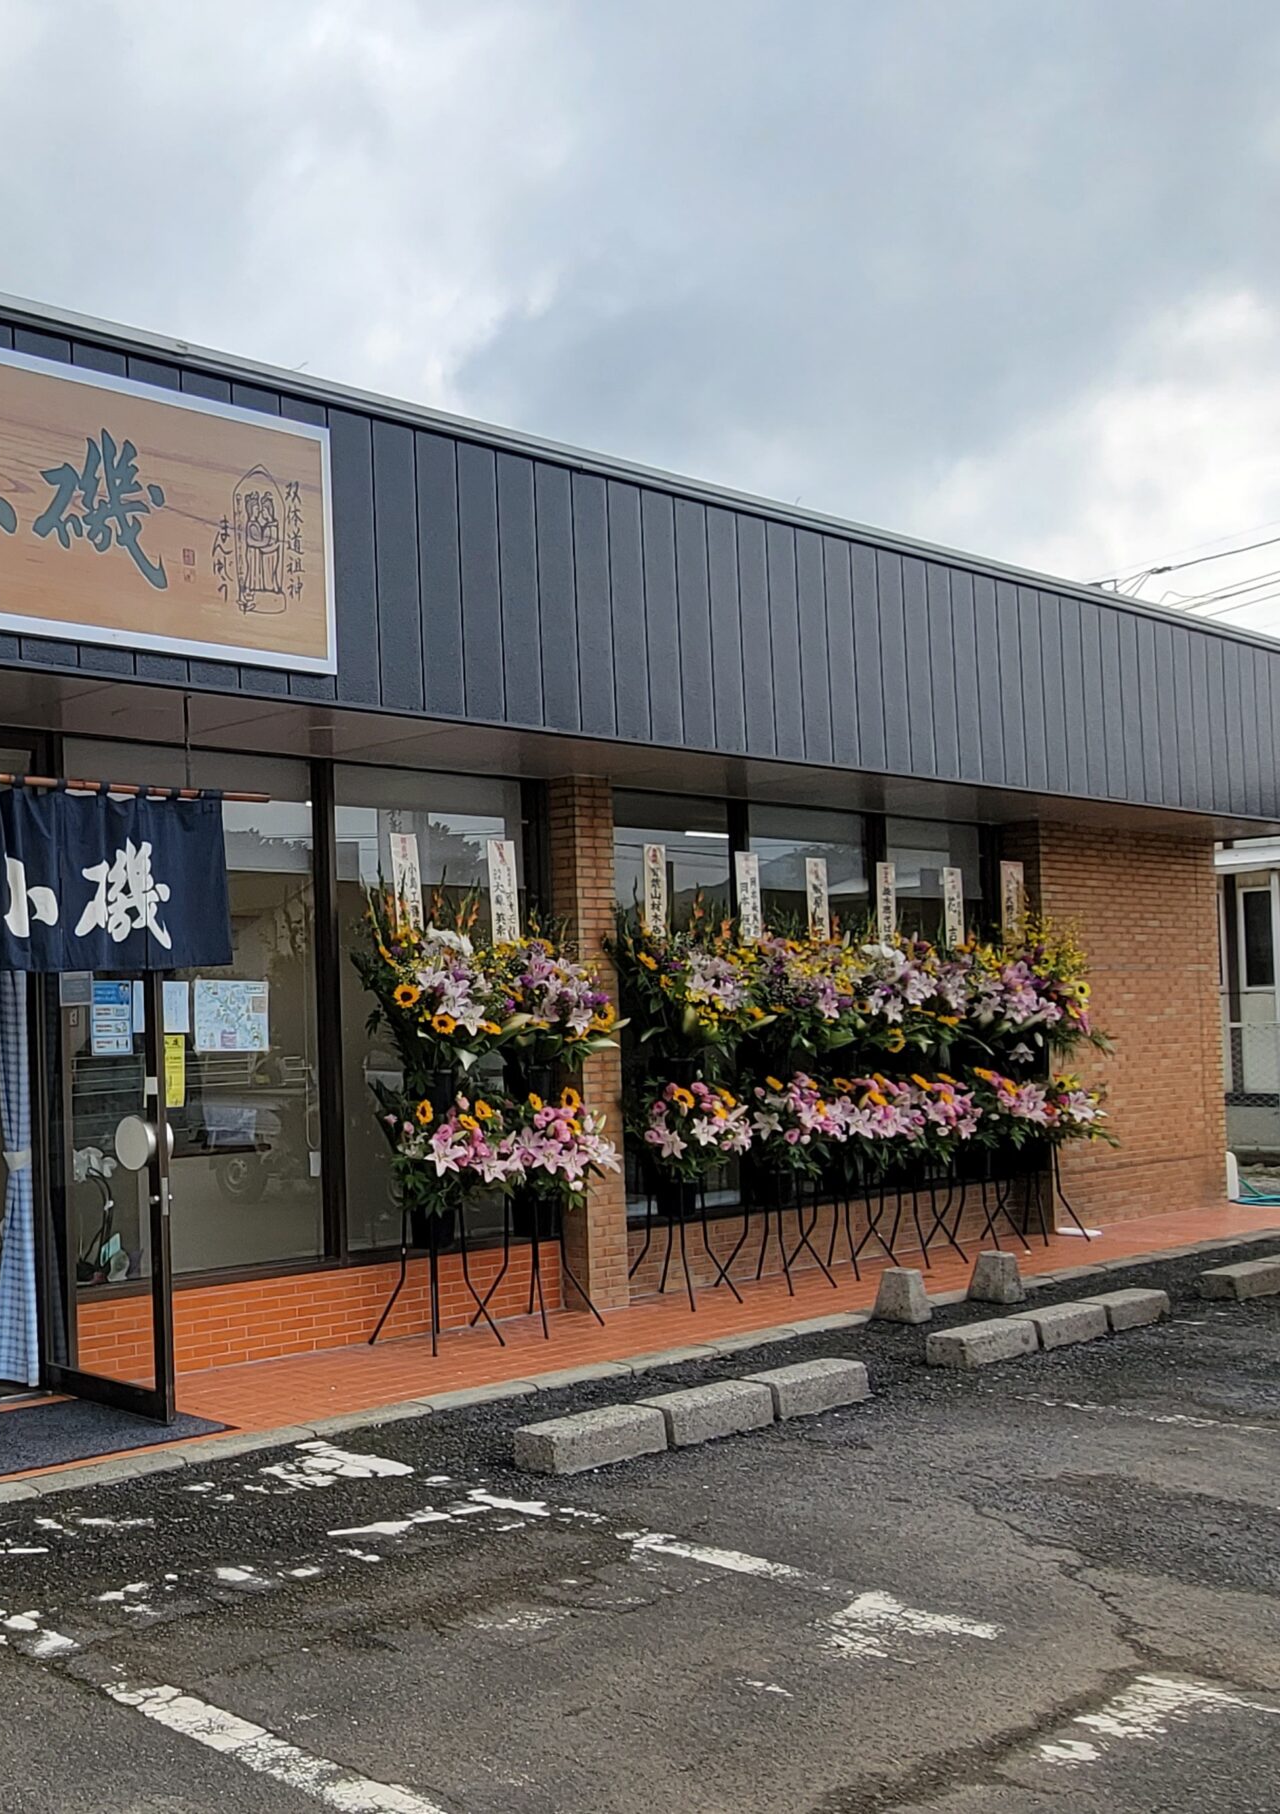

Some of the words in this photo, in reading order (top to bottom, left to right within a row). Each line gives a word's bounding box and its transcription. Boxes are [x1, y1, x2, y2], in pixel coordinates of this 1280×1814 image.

[285, 480, 306, 602] 双体道祖神
